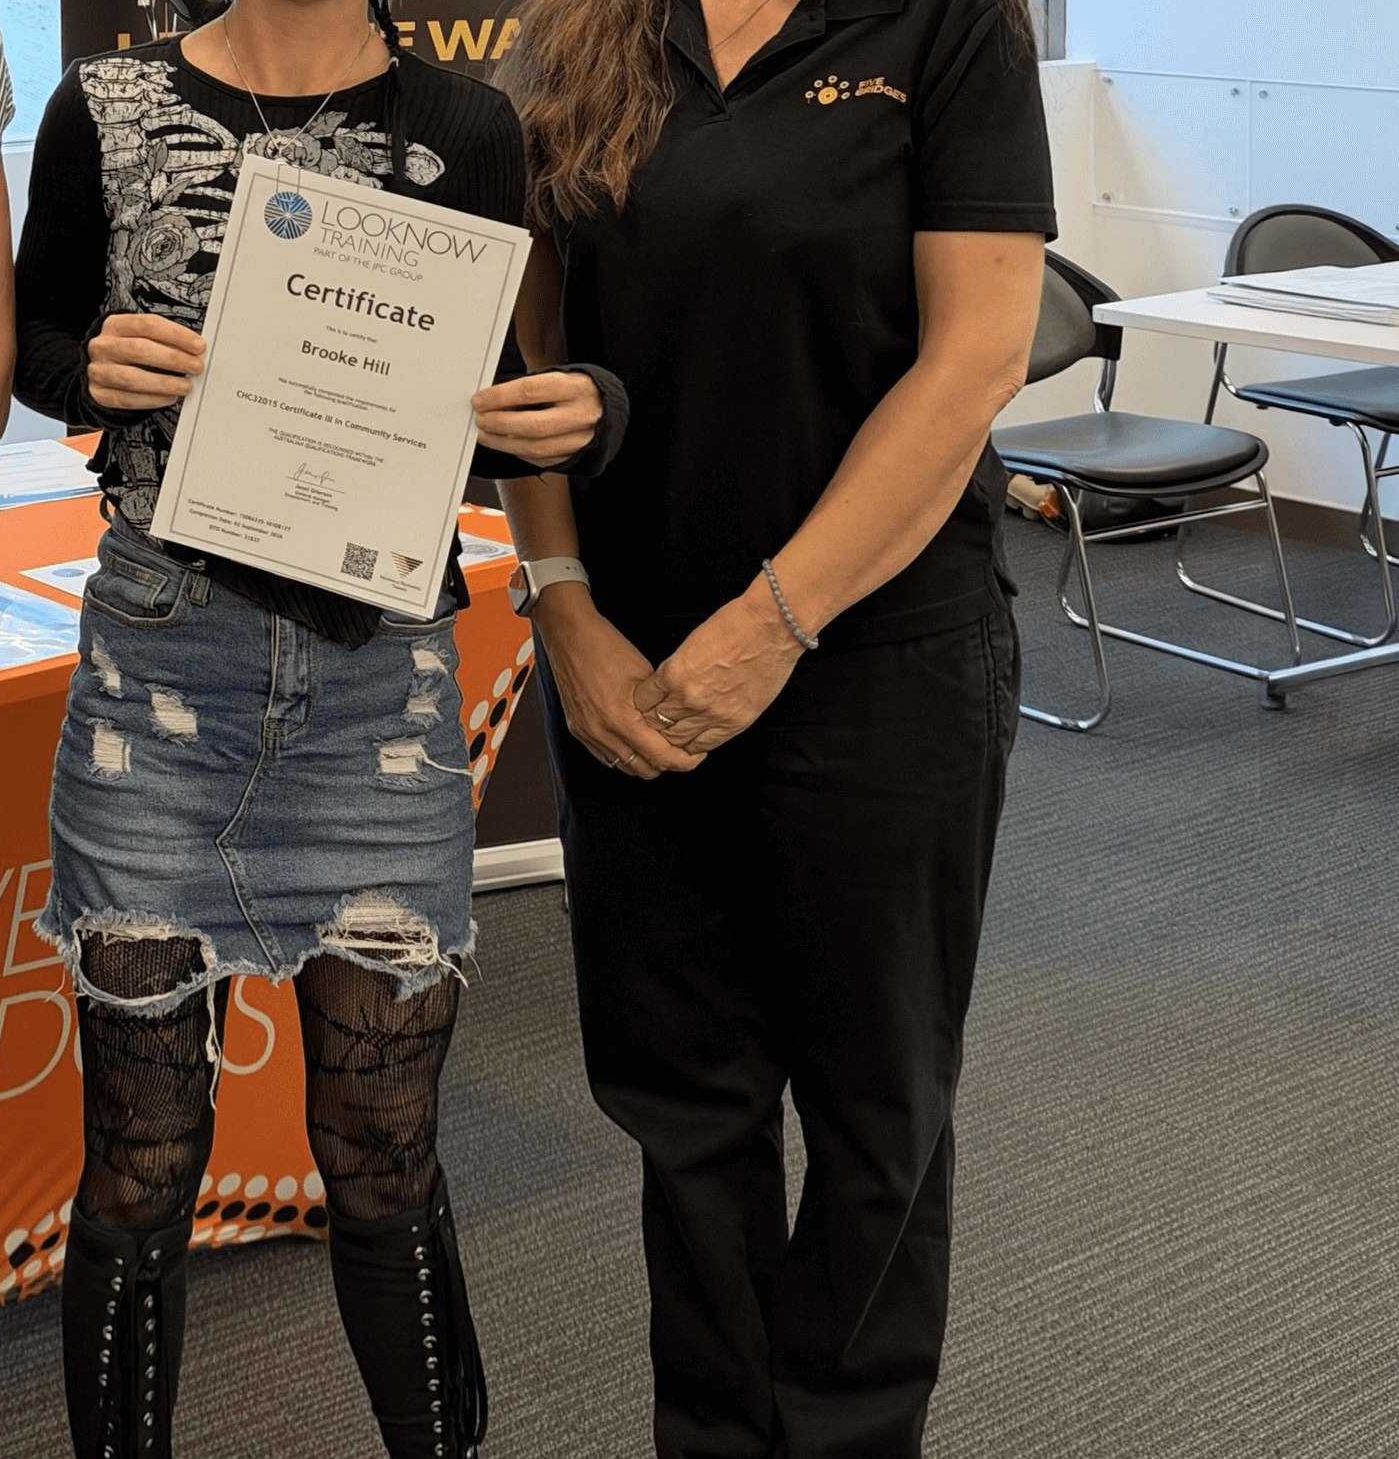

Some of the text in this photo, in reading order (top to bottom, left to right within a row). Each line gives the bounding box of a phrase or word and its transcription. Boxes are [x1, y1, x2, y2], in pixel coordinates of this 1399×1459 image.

[854, 85, 907, 103] BRIDGES
[859, 77, 886, 89] FIVE
[319, 226, 420, 268] TRAINING
[321, 201, 488, 264] LOOKNOW
[313, 246, 336, 259] PART
[338, 253, 351, 263] OF
[352, 256, 370, 269] THE
[389, 266, 423, 281] GROUP
[286, 273, 435, 331] Certificate
[301, 340, 391, 376] Brooke Hill
[236, 390, 278, 408] CHC32015
[279, 402, 323, 420] Certificate
[344, 420, 391, 440] Community
[392, 433, 427, 449] Services
